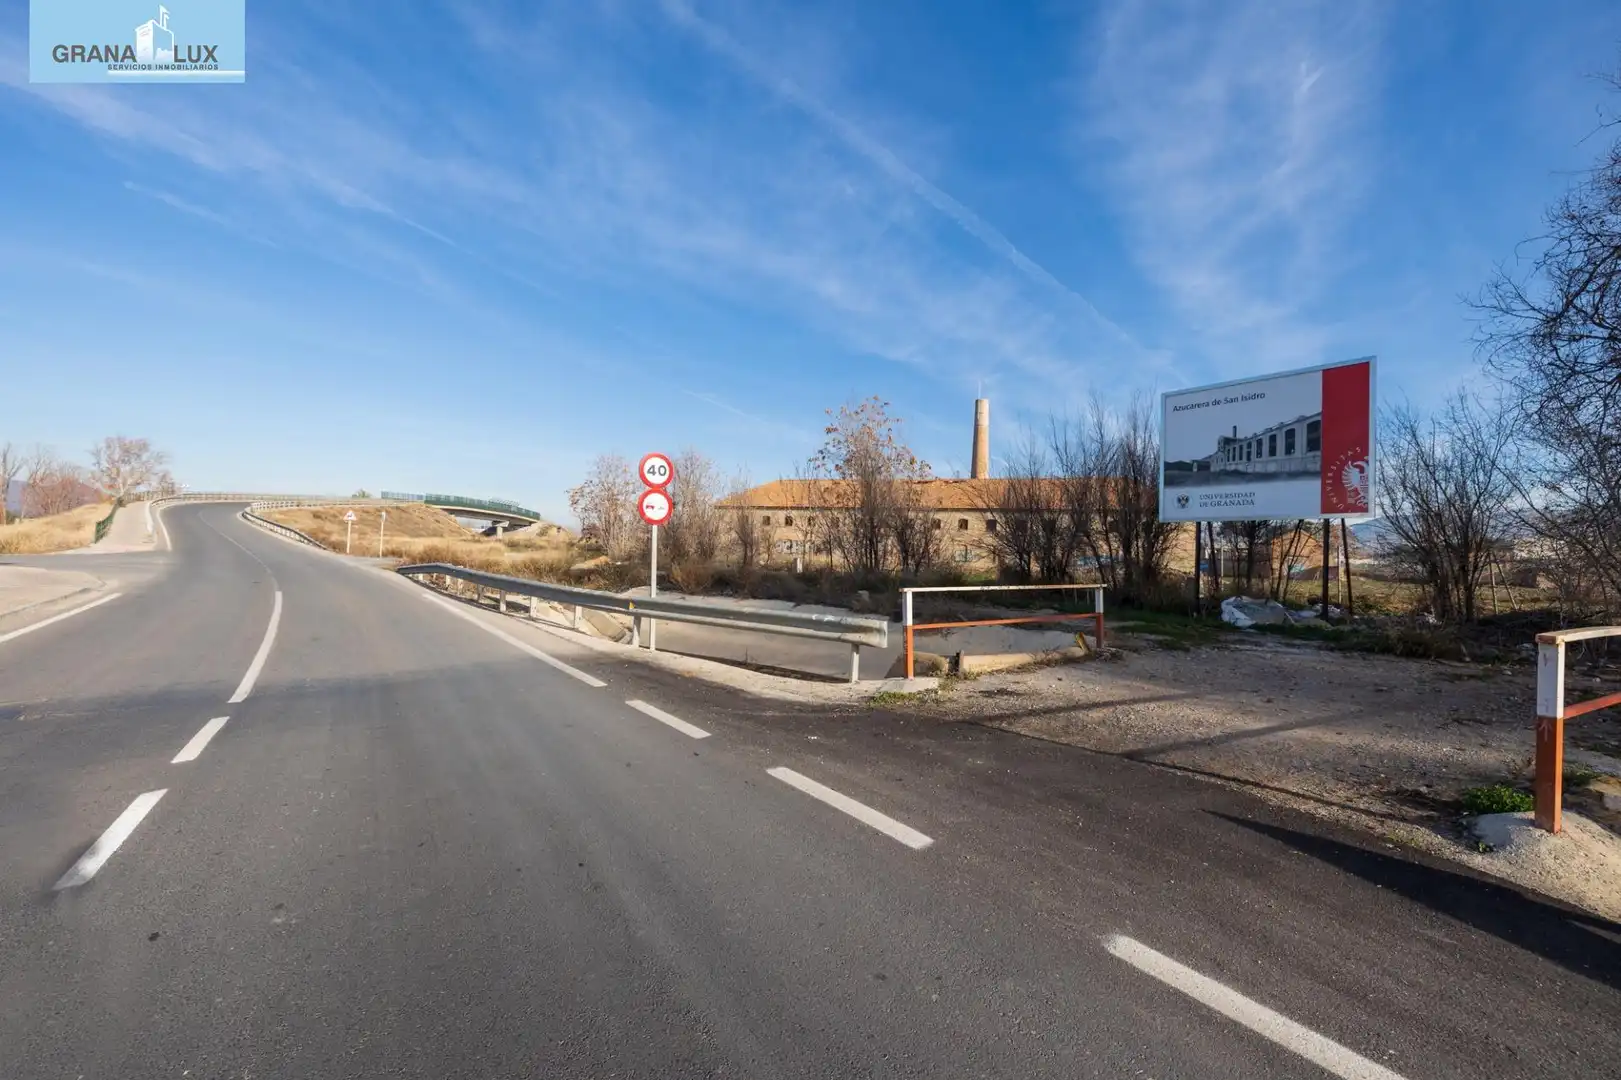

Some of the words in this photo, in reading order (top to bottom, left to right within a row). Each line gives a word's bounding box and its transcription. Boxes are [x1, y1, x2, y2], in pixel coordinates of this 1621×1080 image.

[1172, 402, 1210, 412] Azucarera
[1211, 399, 1222, 407] de
[1223, 396, 1239, 405] San
[1241, 392, 1266, 402] Isidro
[646, 464, 667, 477] 40
[1199, 492, 1256, 500] UNIVERSIDAD
[1210, 499, 1255, 508] GRANADA
